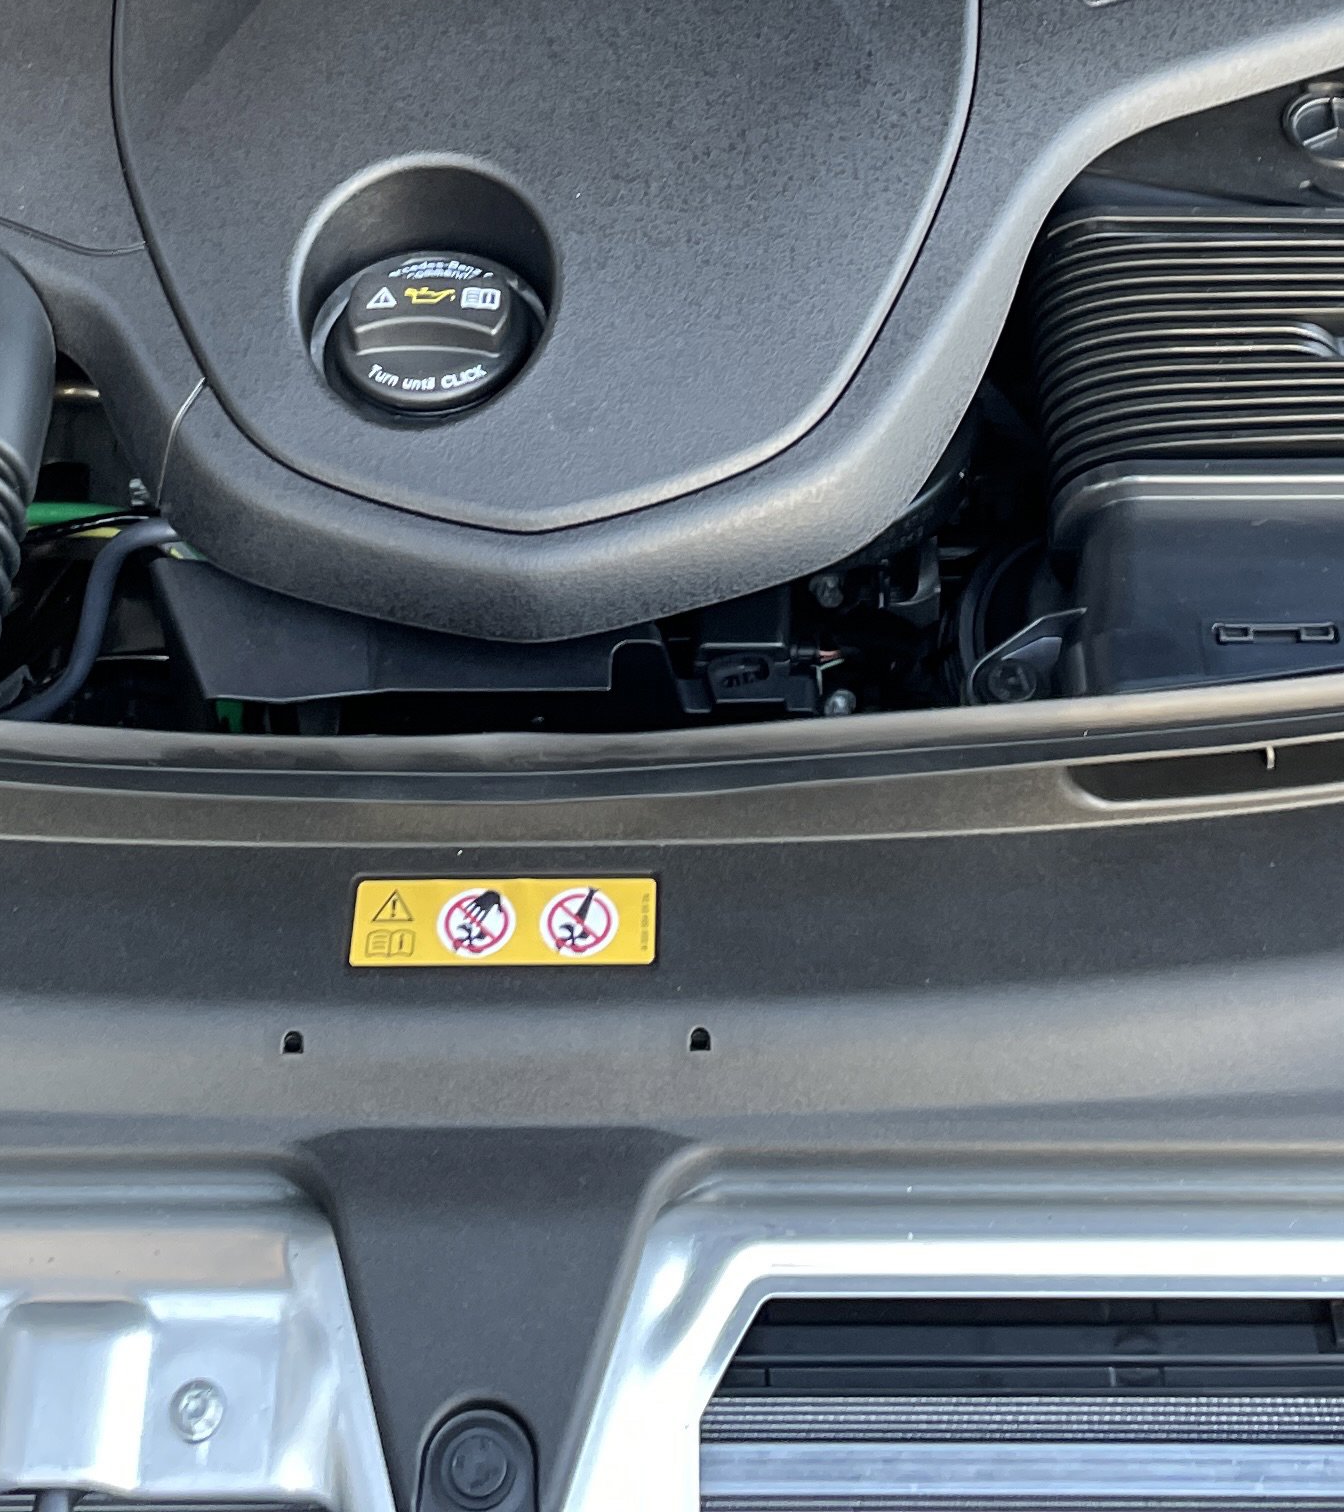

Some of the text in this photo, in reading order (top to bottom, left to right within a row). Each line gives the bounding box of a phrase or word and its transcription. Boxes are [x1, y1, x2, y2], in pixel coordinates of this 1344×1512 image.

[368, 363, 487, 391] Turn until CLICK
